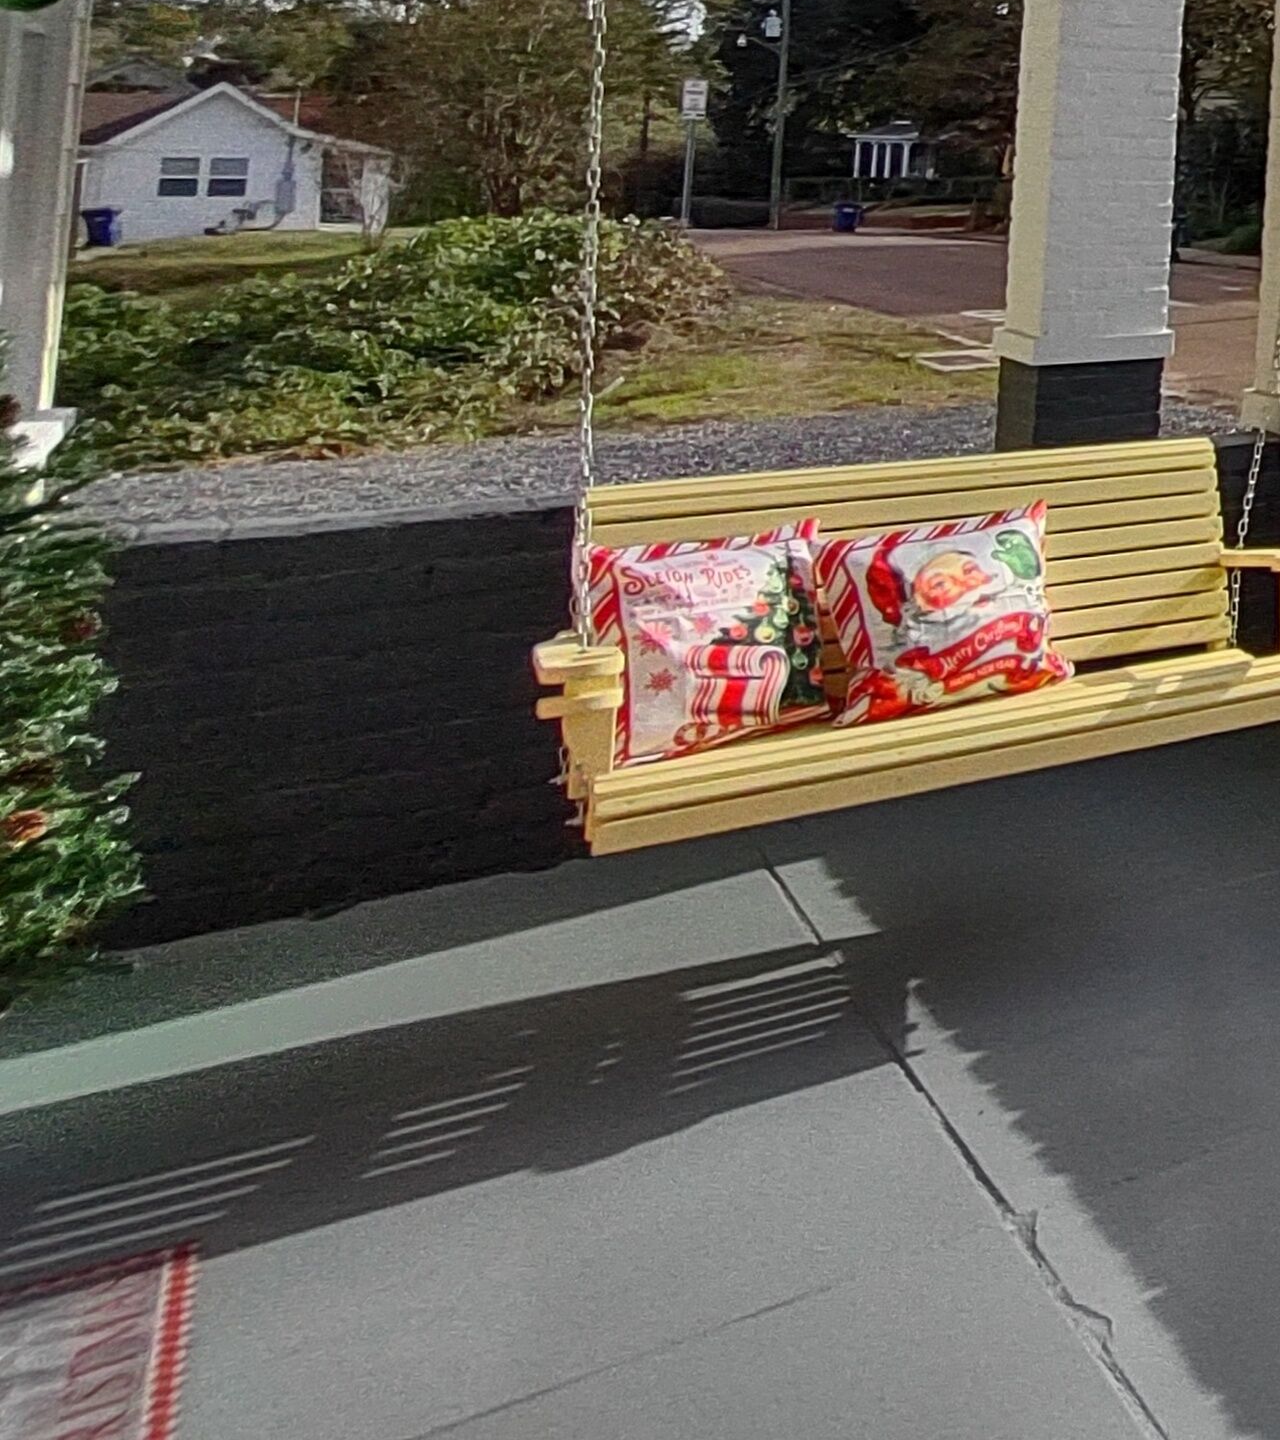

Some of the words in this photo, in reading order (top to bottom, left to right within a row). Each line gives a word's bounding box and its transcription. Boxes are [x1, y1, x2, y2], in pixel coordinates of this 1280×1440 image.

[620, 565, 694, 596] SLEIGH
[700, 564, 752, 589] RIDES
[939, 644, 973, 680] Merry
